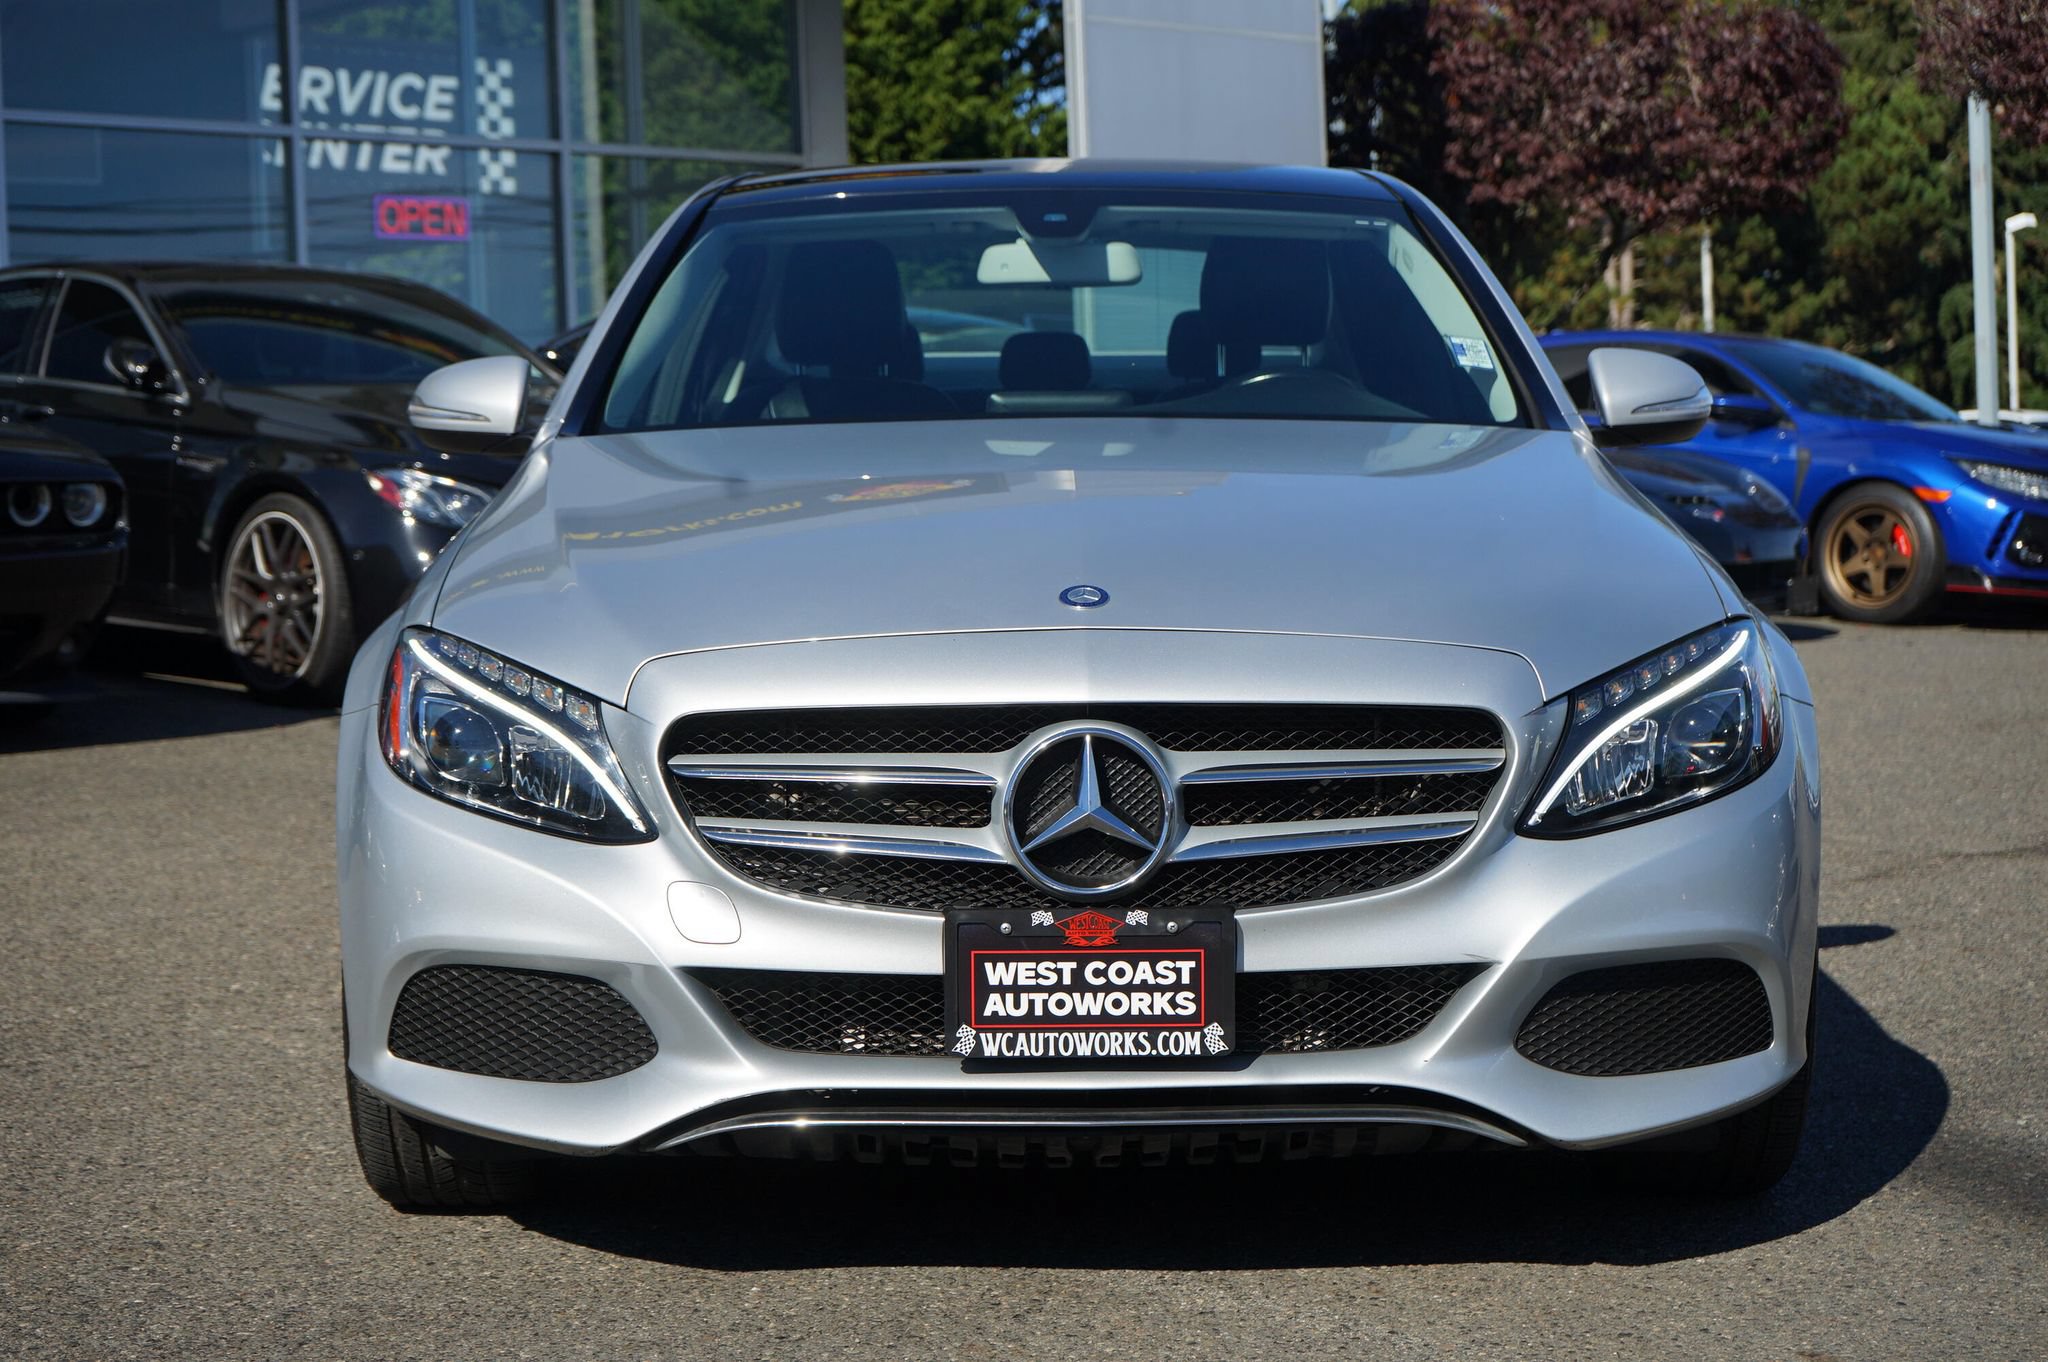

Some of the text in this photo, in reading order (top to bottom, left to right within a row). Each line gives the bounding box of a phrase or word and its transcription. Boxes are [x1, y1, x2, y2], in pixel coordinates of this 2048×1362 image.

[259, 62, 459, 123] ERVICE
[377, 200, 467, 236] OPEN
[984, 960, 1196, 986] WEST COAST
[983, 991, 1197, 1017] AUTOWORKS
[979, 1031, 1202, 1057] WCAUTOWORKS.COM
